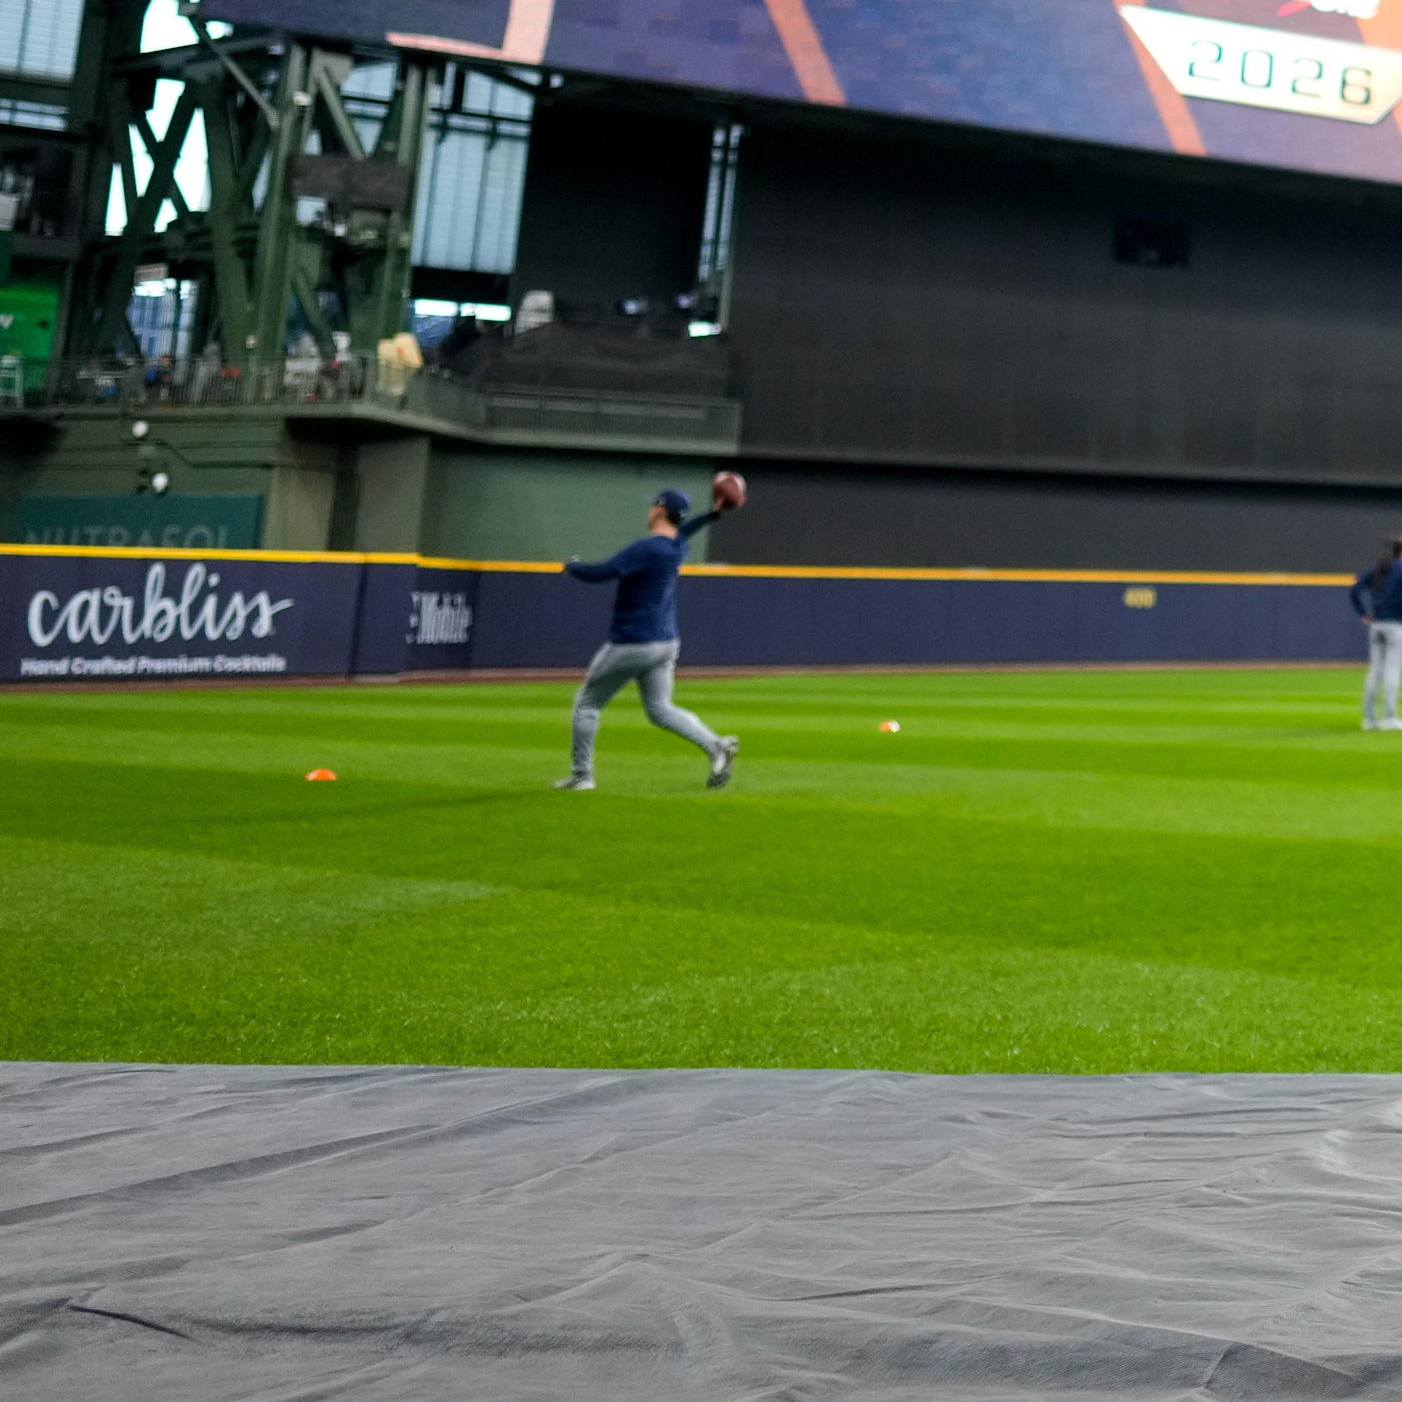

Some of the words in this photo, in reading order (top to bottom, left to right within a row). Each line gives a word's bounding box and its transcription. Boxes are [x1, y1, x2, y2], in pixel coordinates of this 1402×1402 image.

[1187, 40, 1373, 106] 2026
[27, 561, 294, 648] carbliss
[20, 658, 69, 677] Hand
[70, 655, 136, 675] Crafted
[137, 653, 211, 674] Premium
[212, 651, 288, 673] Cocktails
